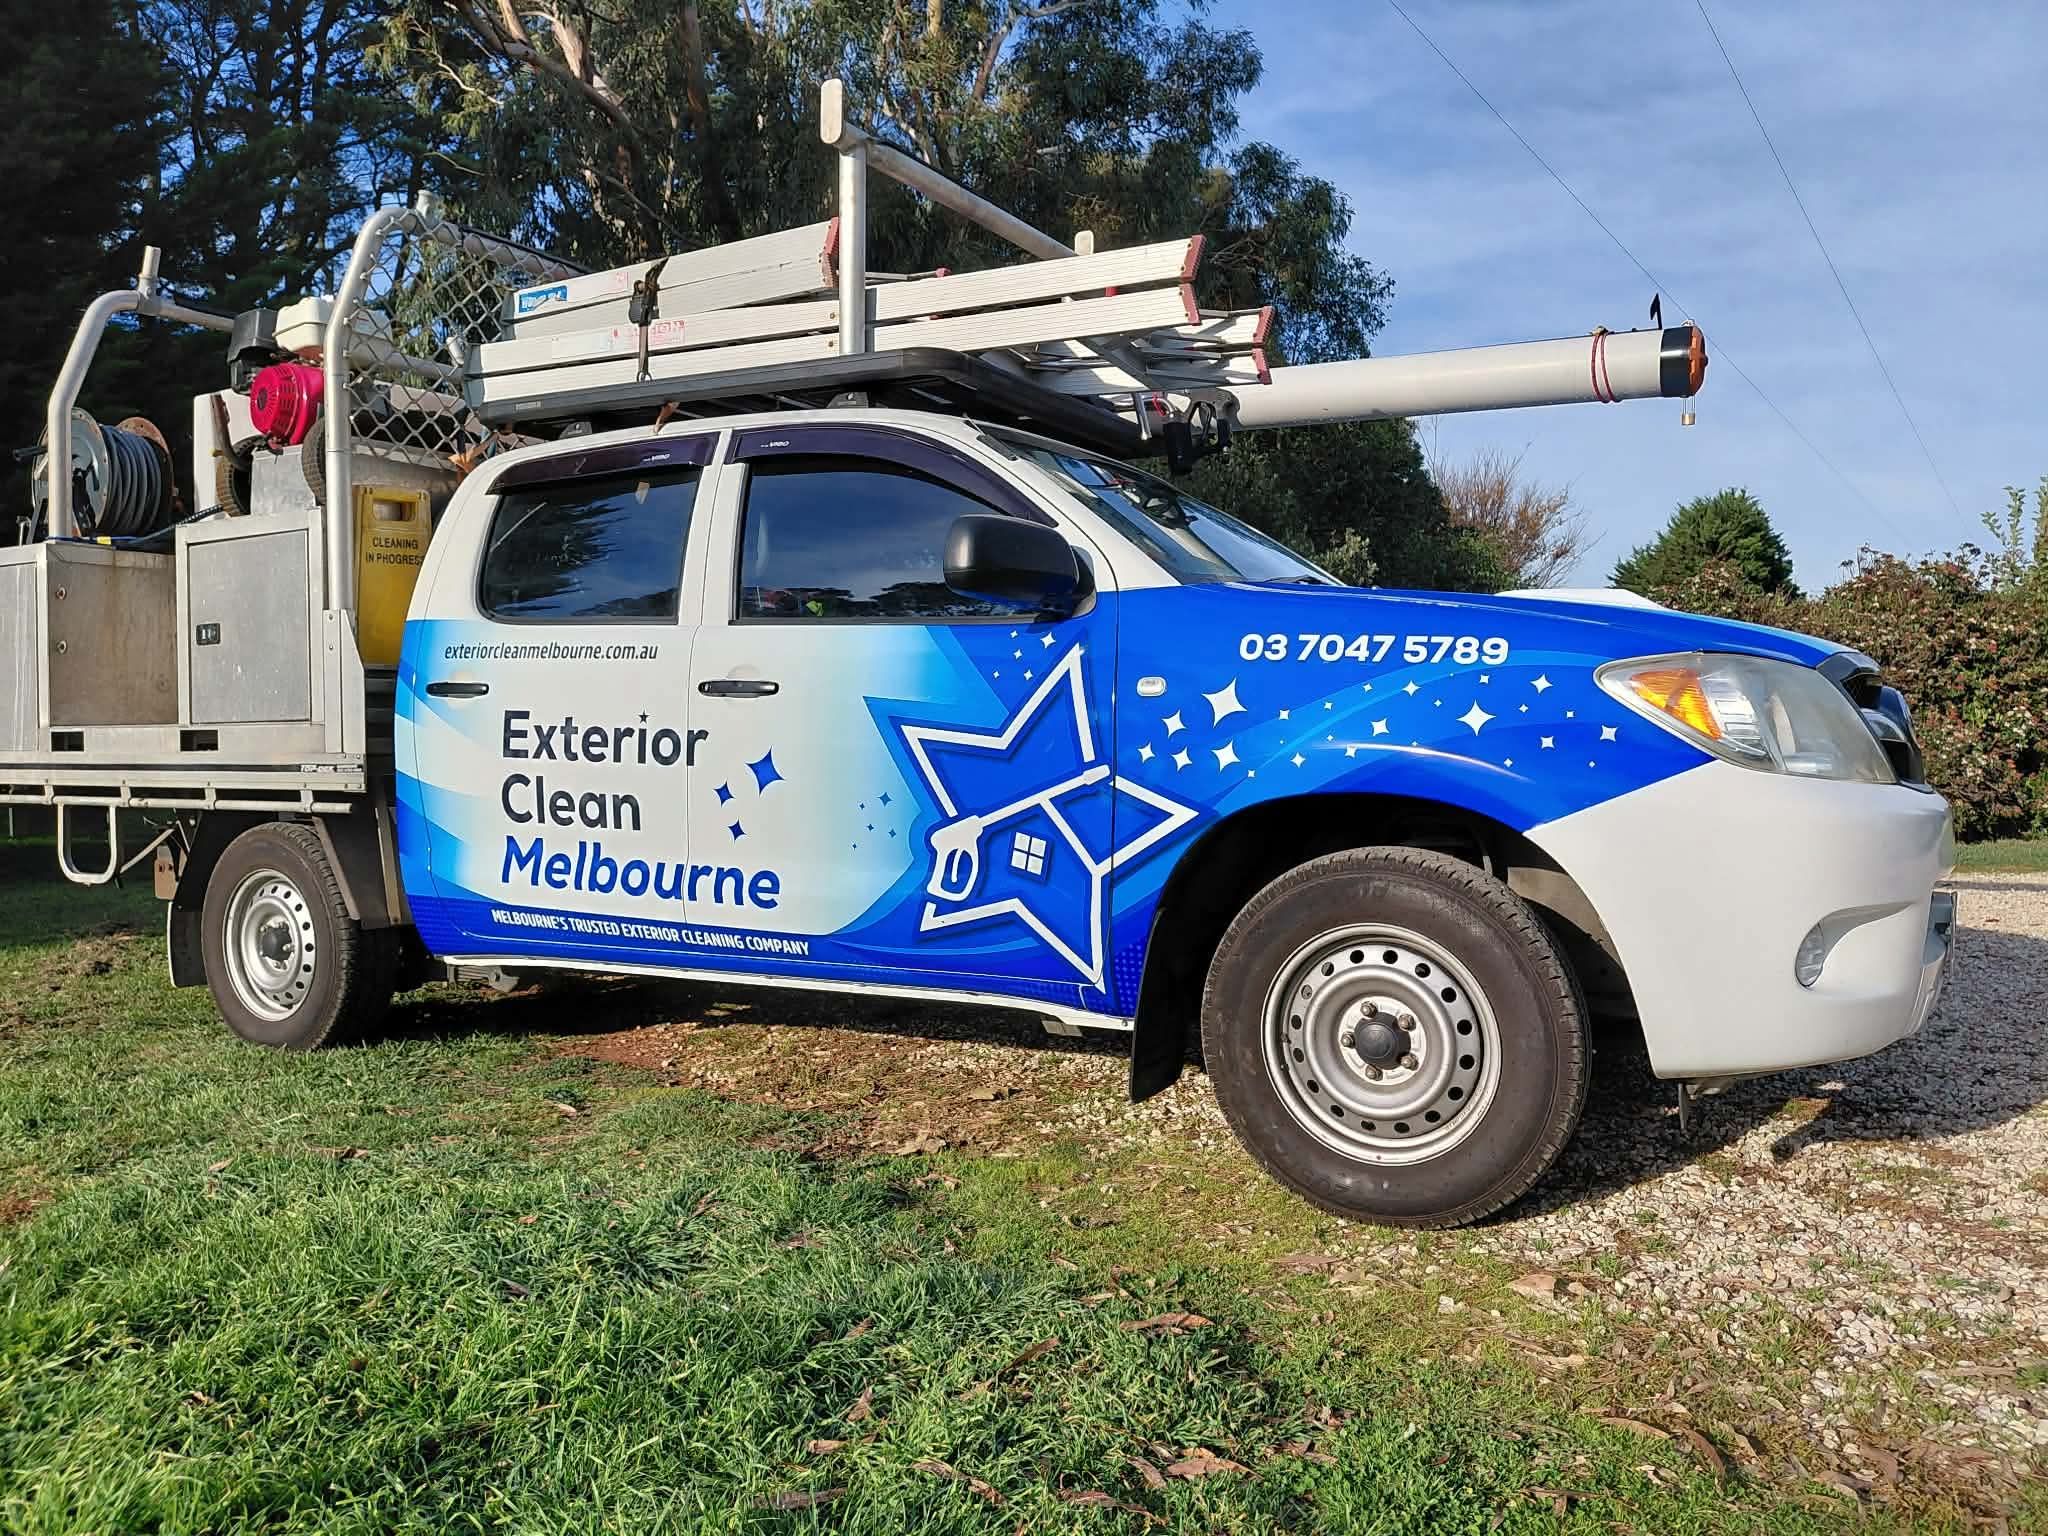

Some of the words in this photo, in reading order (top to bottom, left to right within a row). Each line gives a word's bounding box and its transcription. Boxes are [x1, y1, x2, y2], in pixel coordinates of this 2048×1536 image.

[365, 551, 375, 563] IN
[372, 536, 418, 550] CLEANING
[444, 642, 659, 660] exteriorcleanmelbourne.com.au
[1239, 633, 1288, 661] 03
[1297, 634, 1396, 663] 7047
[1403, 635, 1509, 666] 5789
[502, 710, 709, 767] Exterior
[501, 773, 641, 831] Clean
[501, 835, 780, 909] Melbourne
[491, 908, 568, 931] MELBOURNE'S
[568, 917, 620, 937] TRUSTED
[621, 922, 681, 943] EXTERIOR
[682, 929, 745, 950] CLEANING
[746, 936, 810, 957] COMPANY
